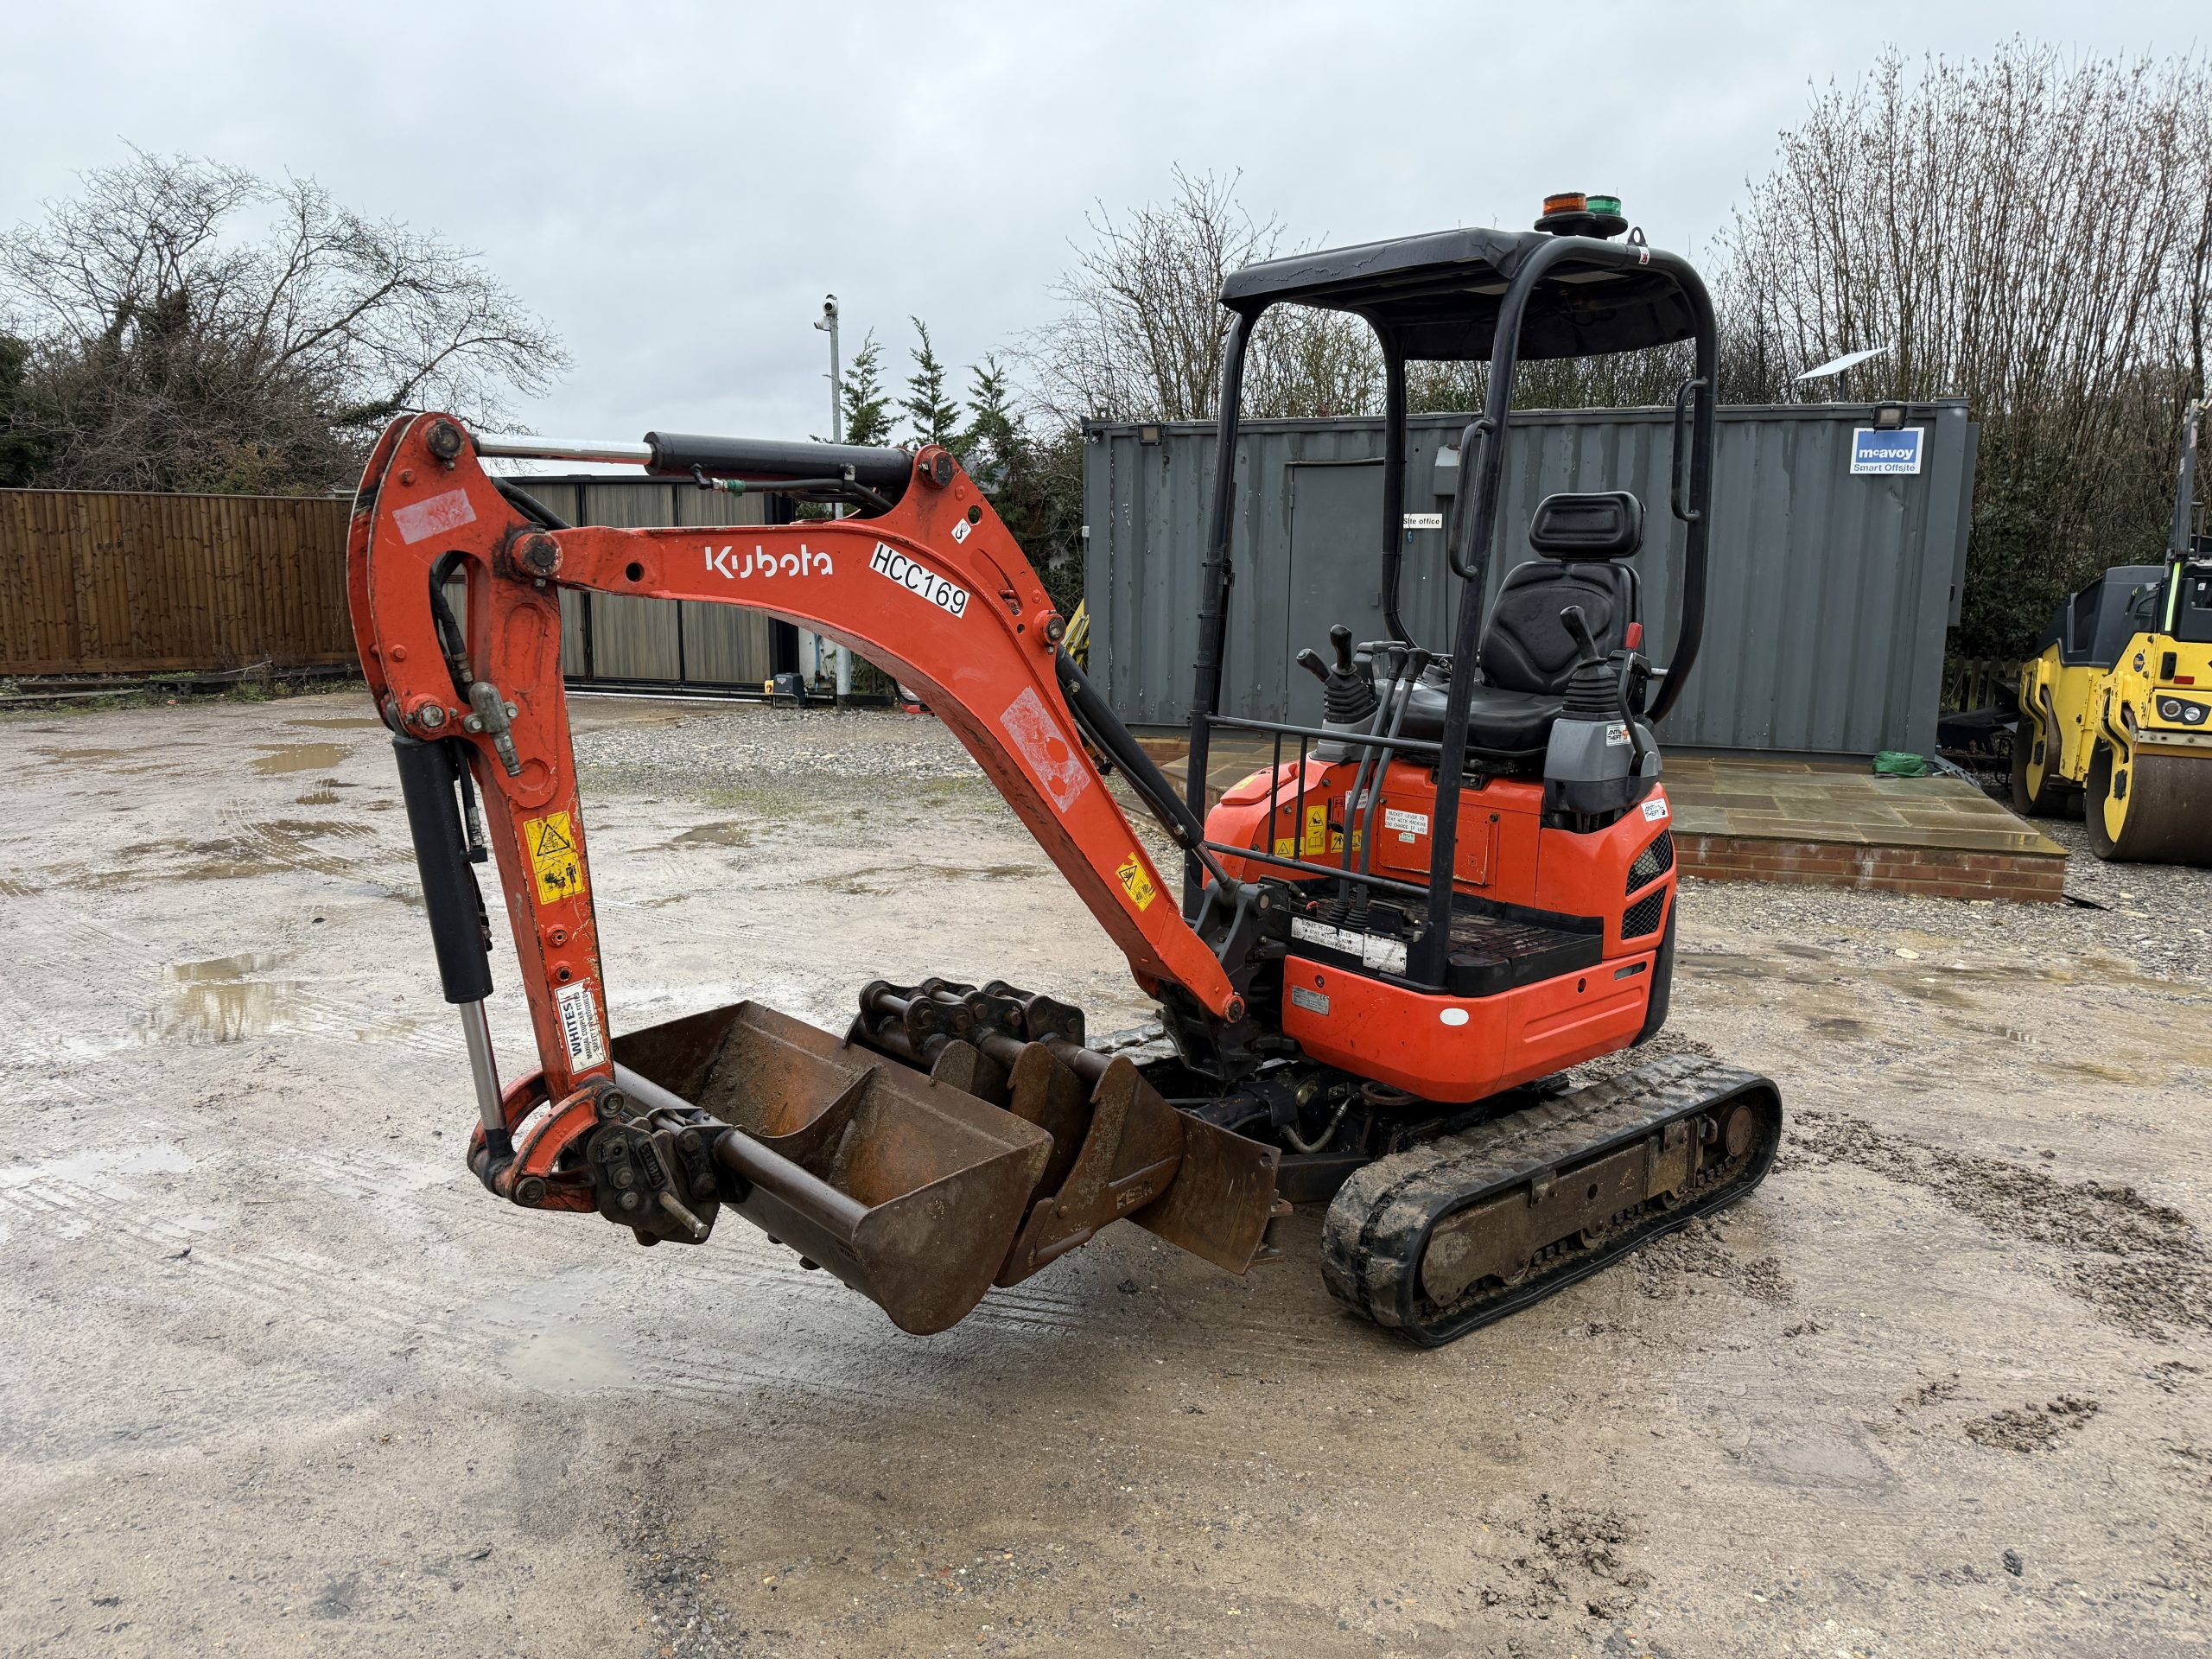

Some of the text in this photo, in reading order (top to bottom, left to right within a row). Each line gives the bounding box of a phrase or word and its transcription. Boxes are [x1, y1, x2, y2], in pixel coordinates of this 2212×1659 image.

[1885, 463, 1916, 472] Offsite
[705, 544, 833, 579] Kubota
[872, 543, 967, 615] HCC169
[563, 1002, 582, 1057] WHITES
[578, 1011, 588, 1037] COUPLER
[583, 1037, 593, 1059] MANUAL
[591, 1033, 600, 1052] SAFETY
